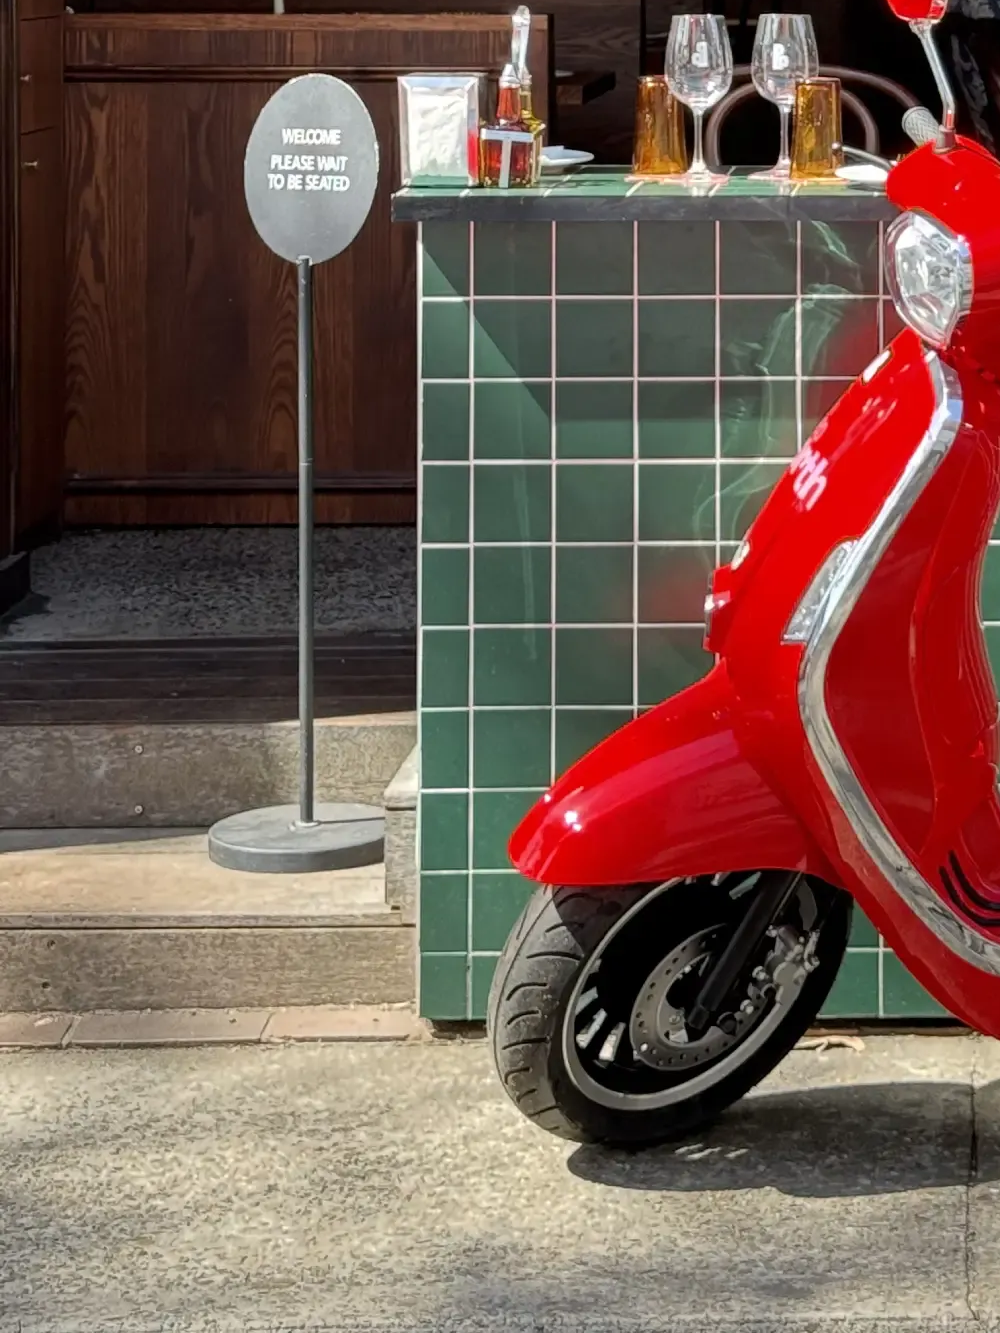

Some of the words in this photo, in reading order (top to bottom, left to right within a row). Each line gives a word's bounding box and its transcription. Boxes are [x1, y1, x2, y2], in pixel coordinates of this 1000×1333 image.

[281, 128, 342, 146] WELCOME
[270, 154, 315, 171] PLEASE
[317, 155, 349, 172] WAIT
[267, 173, 285, 190] TO
[287, 174, 303, 191] BE
[305, 174, 351, 192] SEATED
